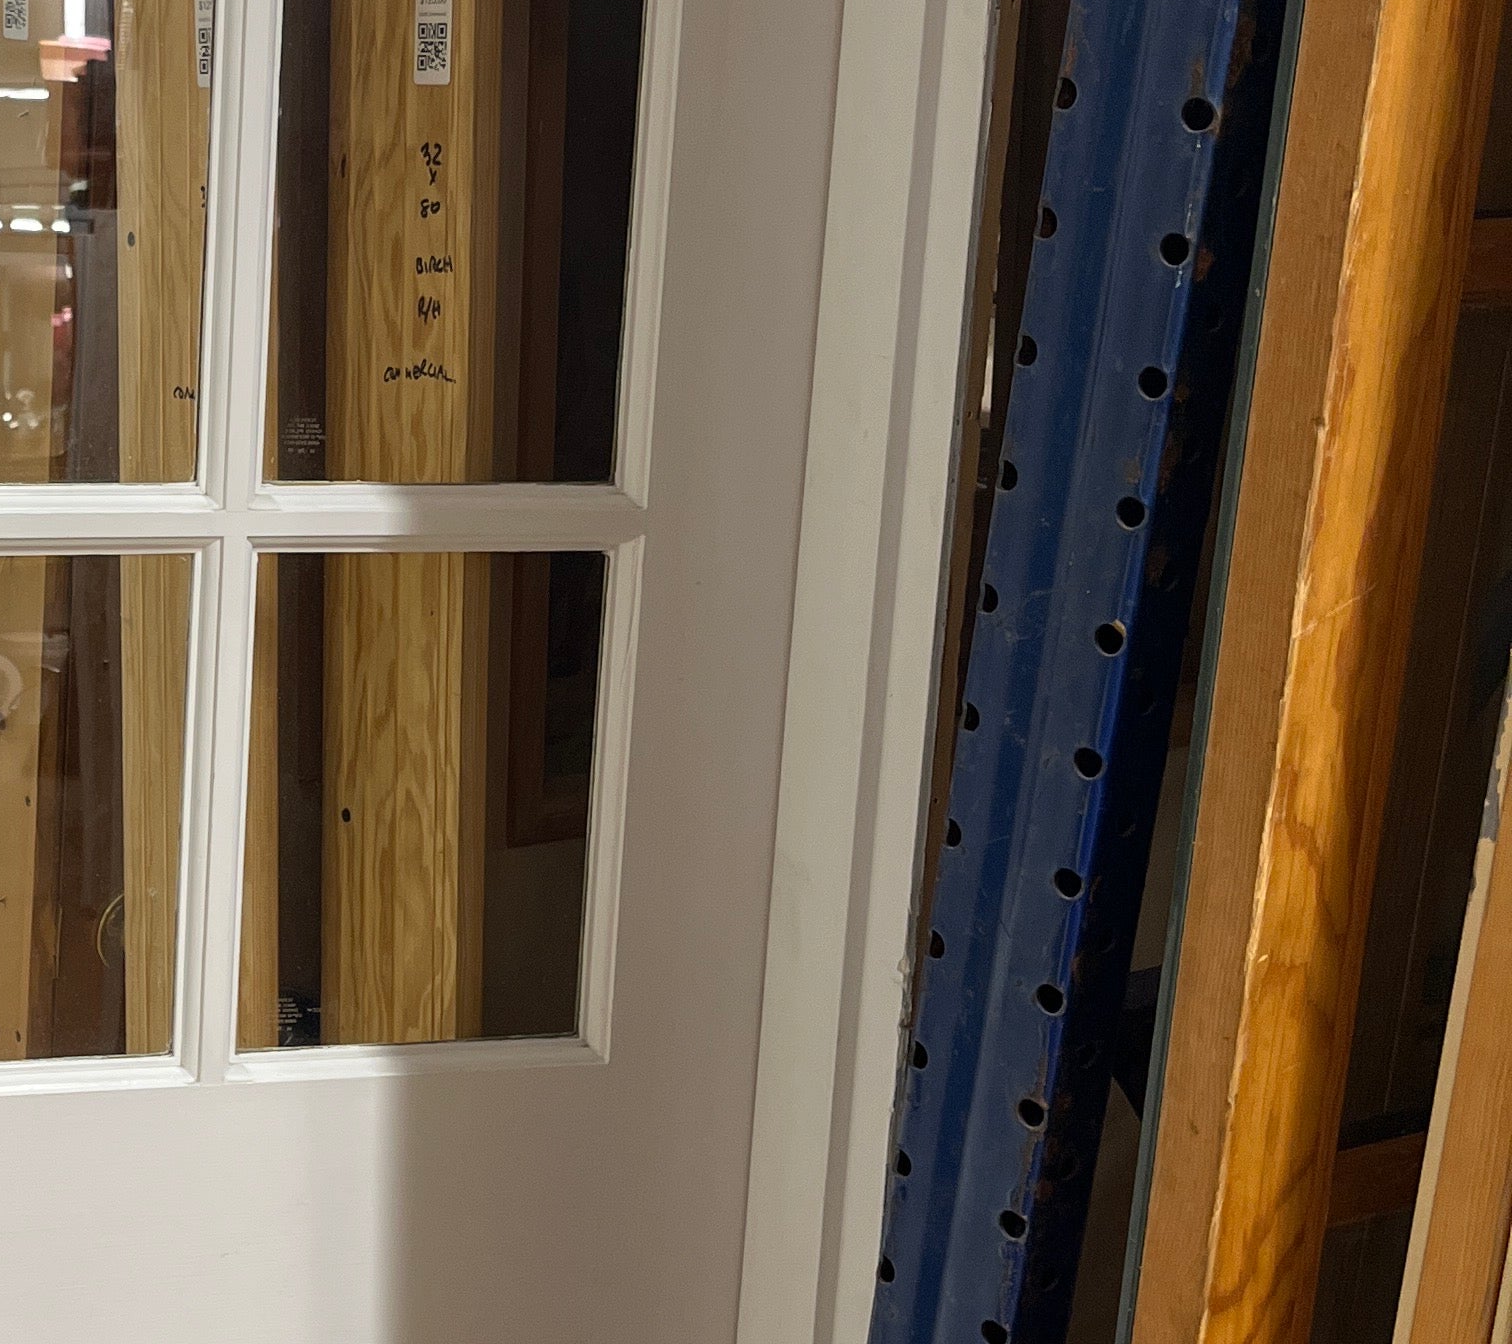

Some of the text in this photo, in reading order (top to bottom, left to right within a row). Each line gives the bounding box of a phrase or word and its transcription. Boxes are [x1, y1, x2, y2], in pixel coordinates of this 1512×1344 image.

[420, 142, 442, 166] 32
[420, 198, 441, 218] 80
[415, 255, 454, 274] BIRCH
[418, 296, 441, 324] R/H
